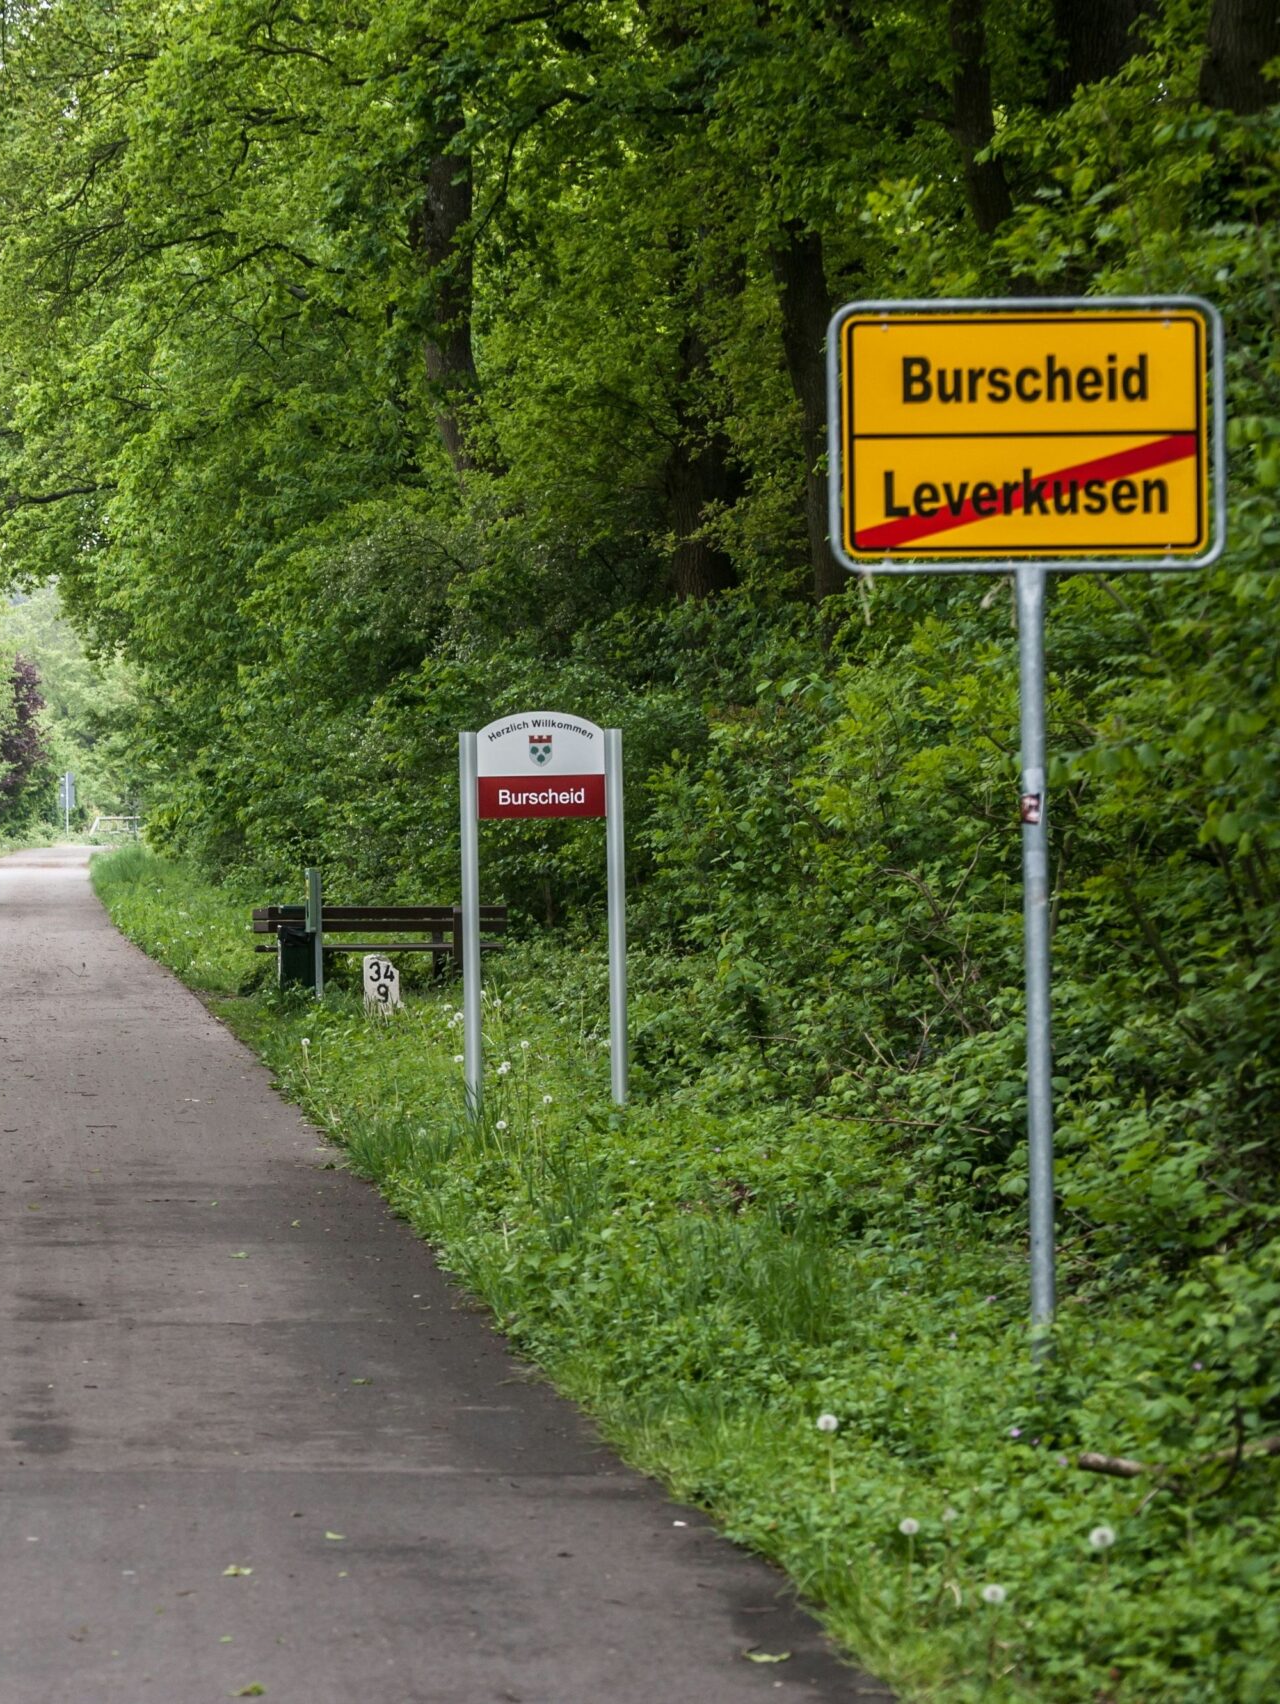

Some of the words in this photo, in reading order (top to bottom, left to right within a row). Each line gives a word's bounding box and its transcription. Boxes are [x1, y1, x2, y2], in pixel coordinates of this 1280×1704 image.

[902, 354, 1148, 404] Burscheid
[884, 468, 1169, 518] Leverkusen
[488, 721, 529, 742] Herzlich
[532, 719, 594, 740] Willkommen
[498, 788, 585, 806] Burscheid
[369, 961, 395, 982] 34
[377, 984, 389, 1003] 9
